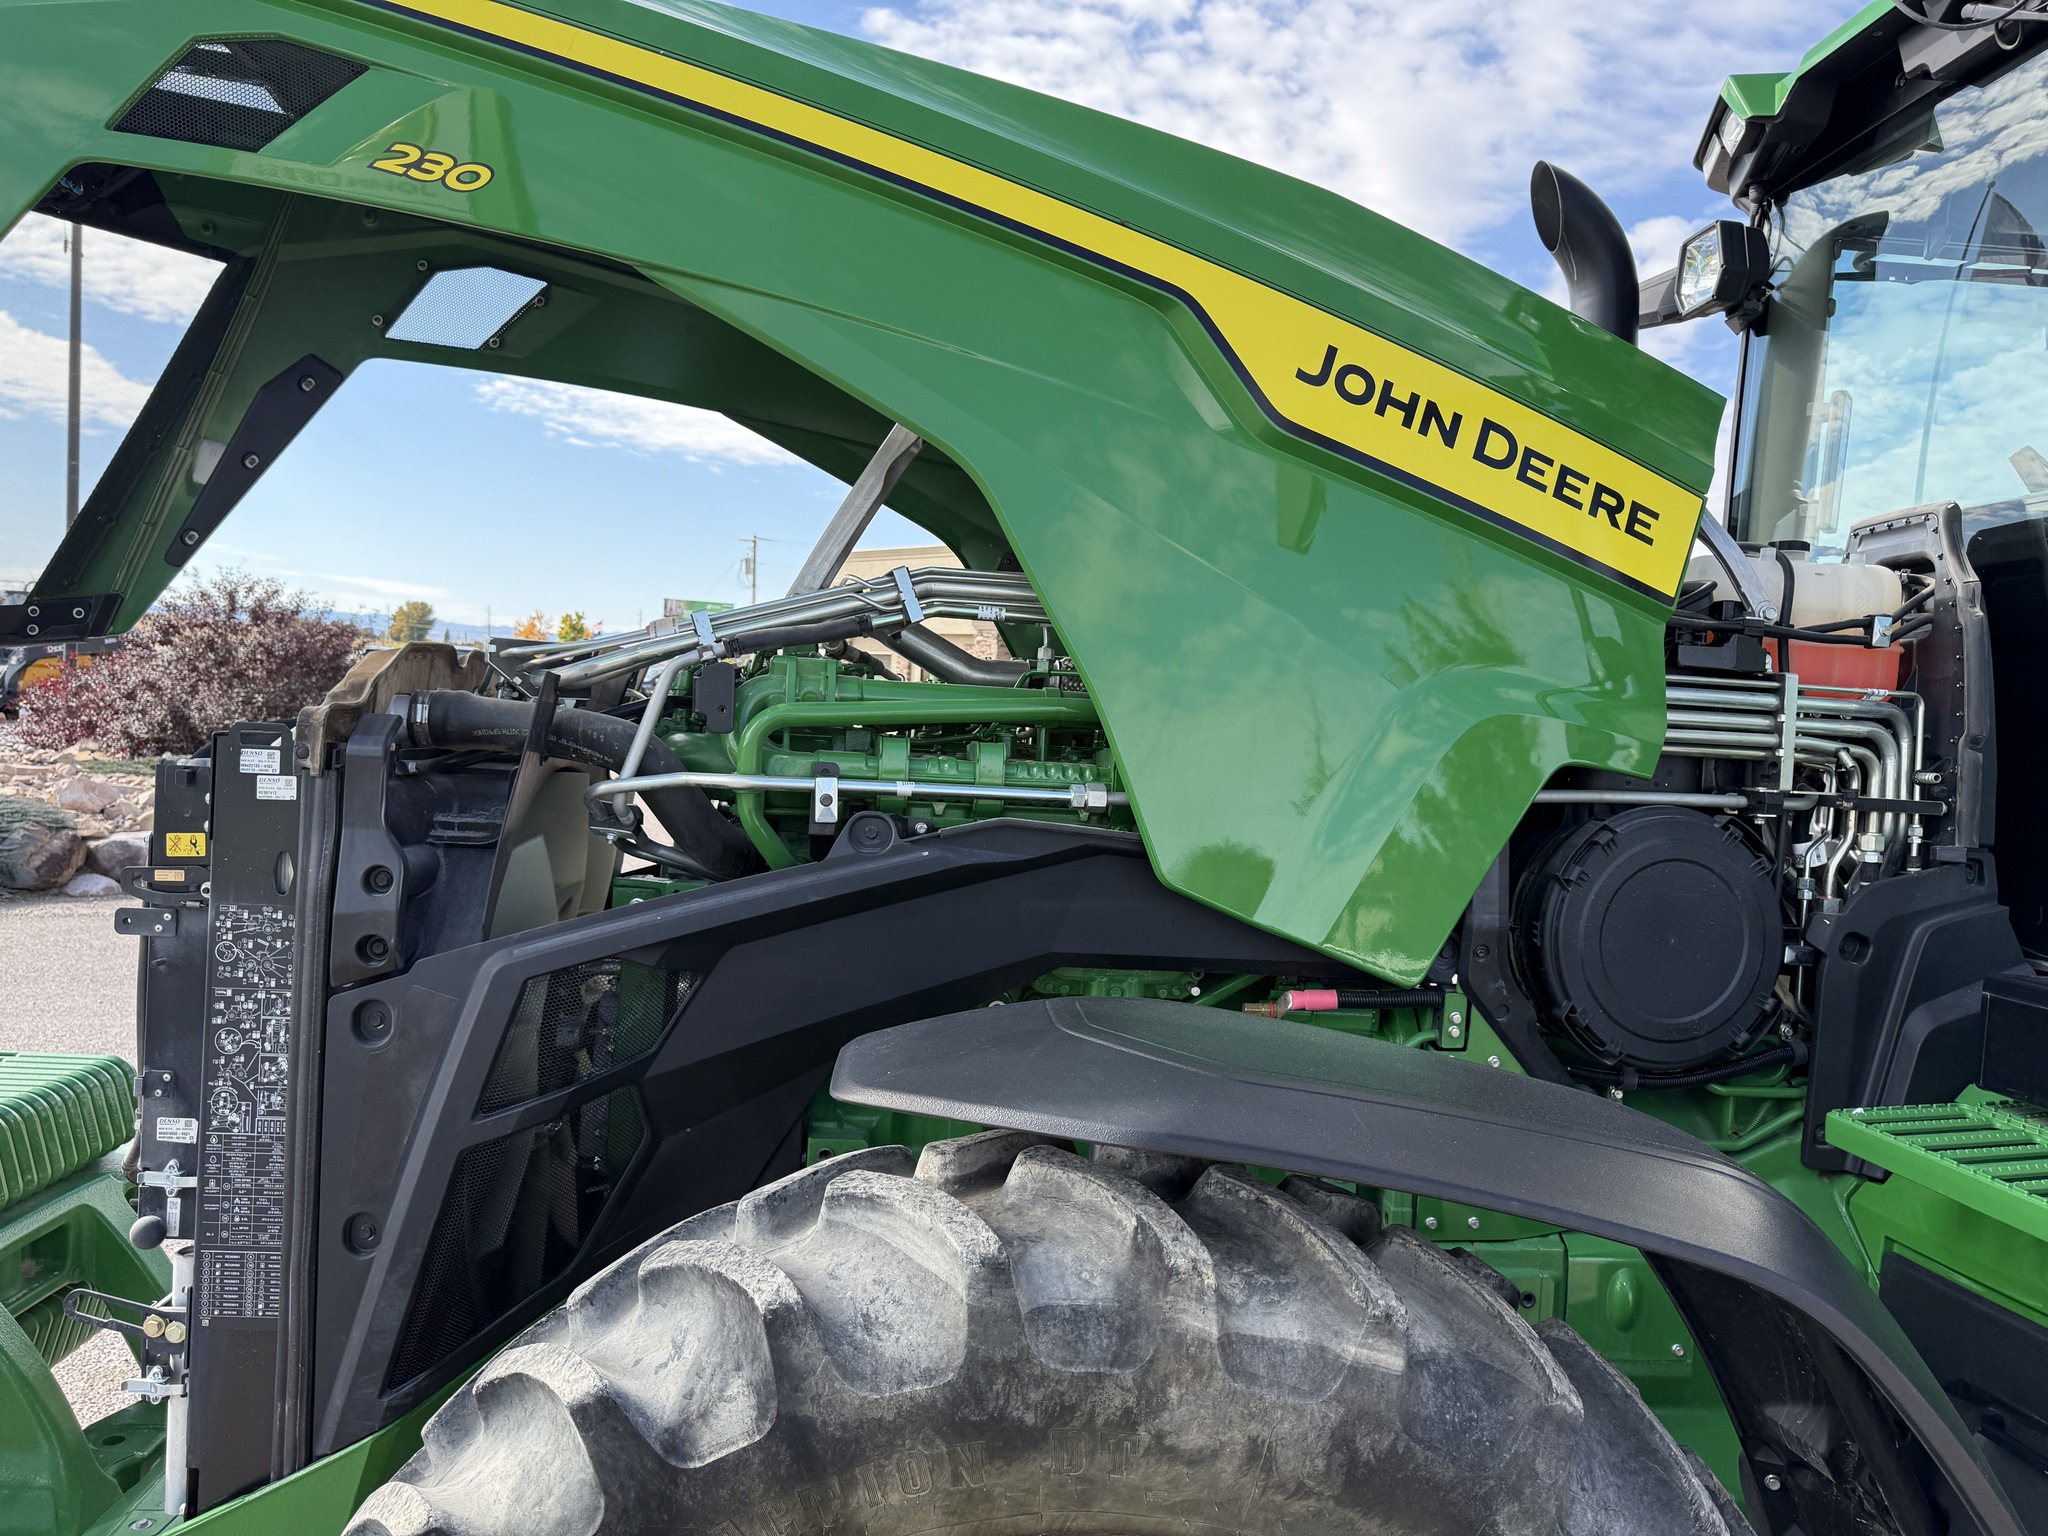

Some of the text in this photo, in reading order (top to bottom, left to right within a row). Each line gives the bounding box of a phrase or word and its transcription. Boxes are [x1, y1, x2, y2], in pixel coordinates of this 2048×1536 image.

[367, 141, 495, 193] 230
[1295, 344, 1660, 547] JOHN DEERE
[1051, 1430, 1142, 1480] DT
